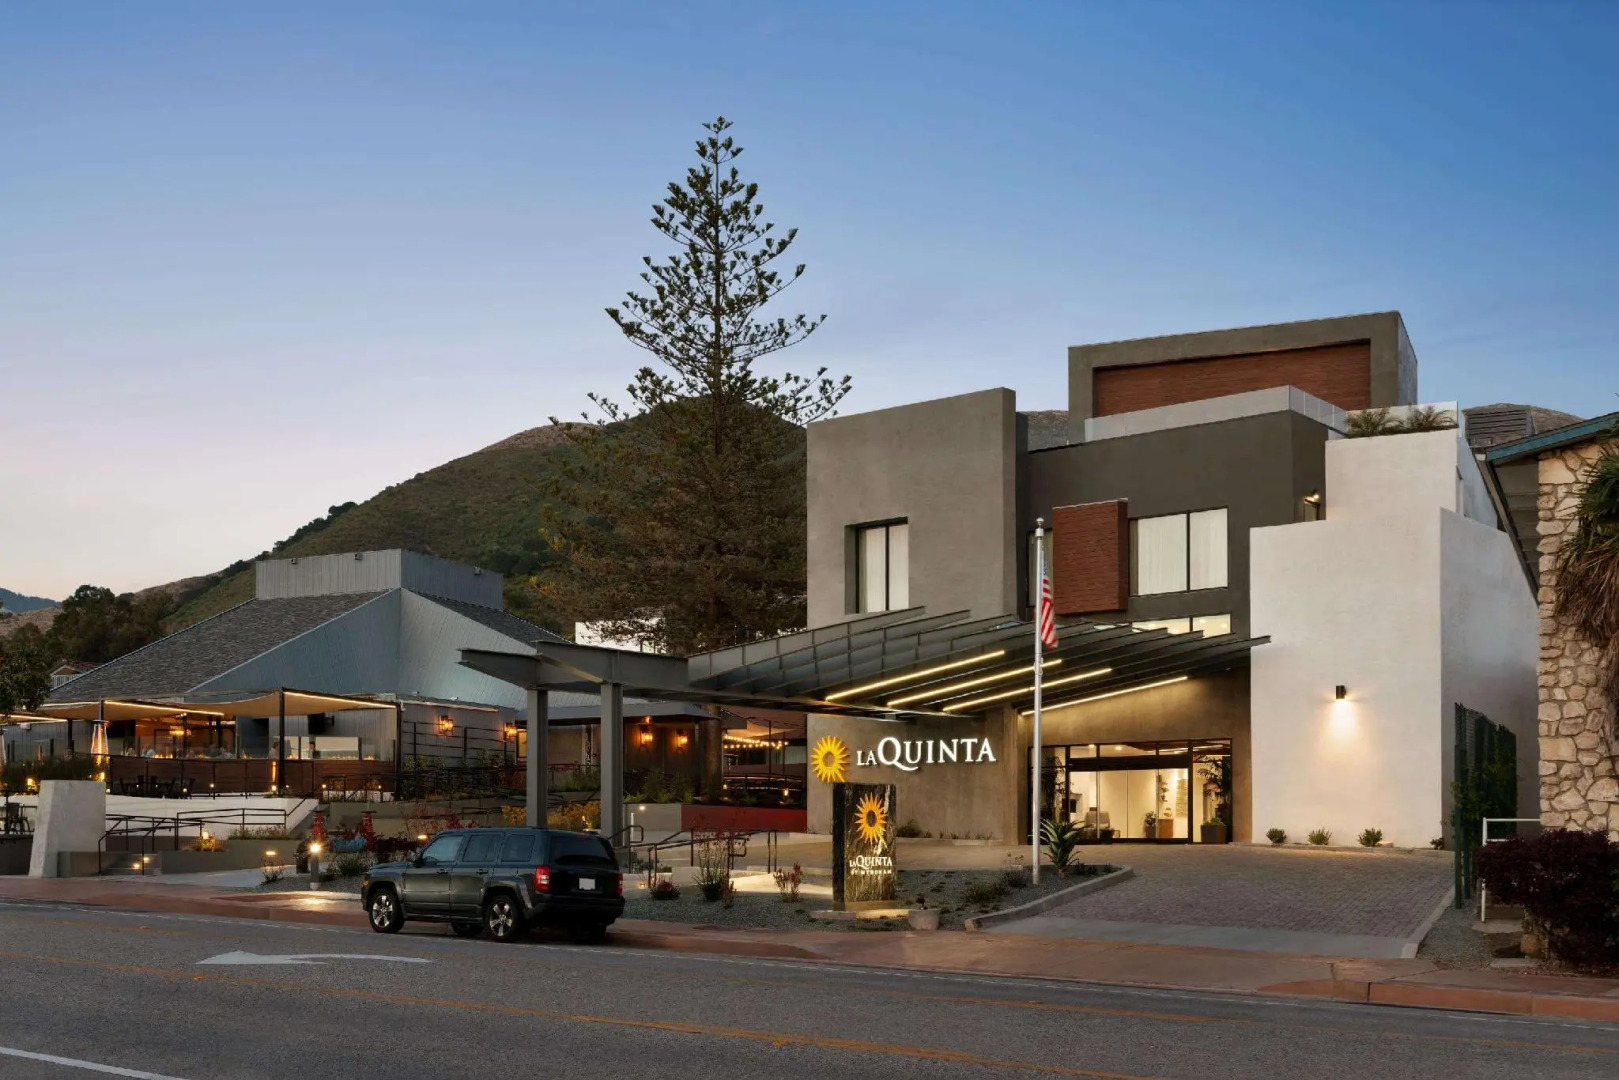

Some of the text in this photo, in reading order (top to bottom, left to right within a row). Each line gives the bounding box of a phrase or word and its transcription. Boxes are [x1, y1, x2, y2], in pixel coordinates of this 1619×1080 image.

[856, 737, 996, 771] LA QUINTA
[856, 855, 892, 870] QUINTA
